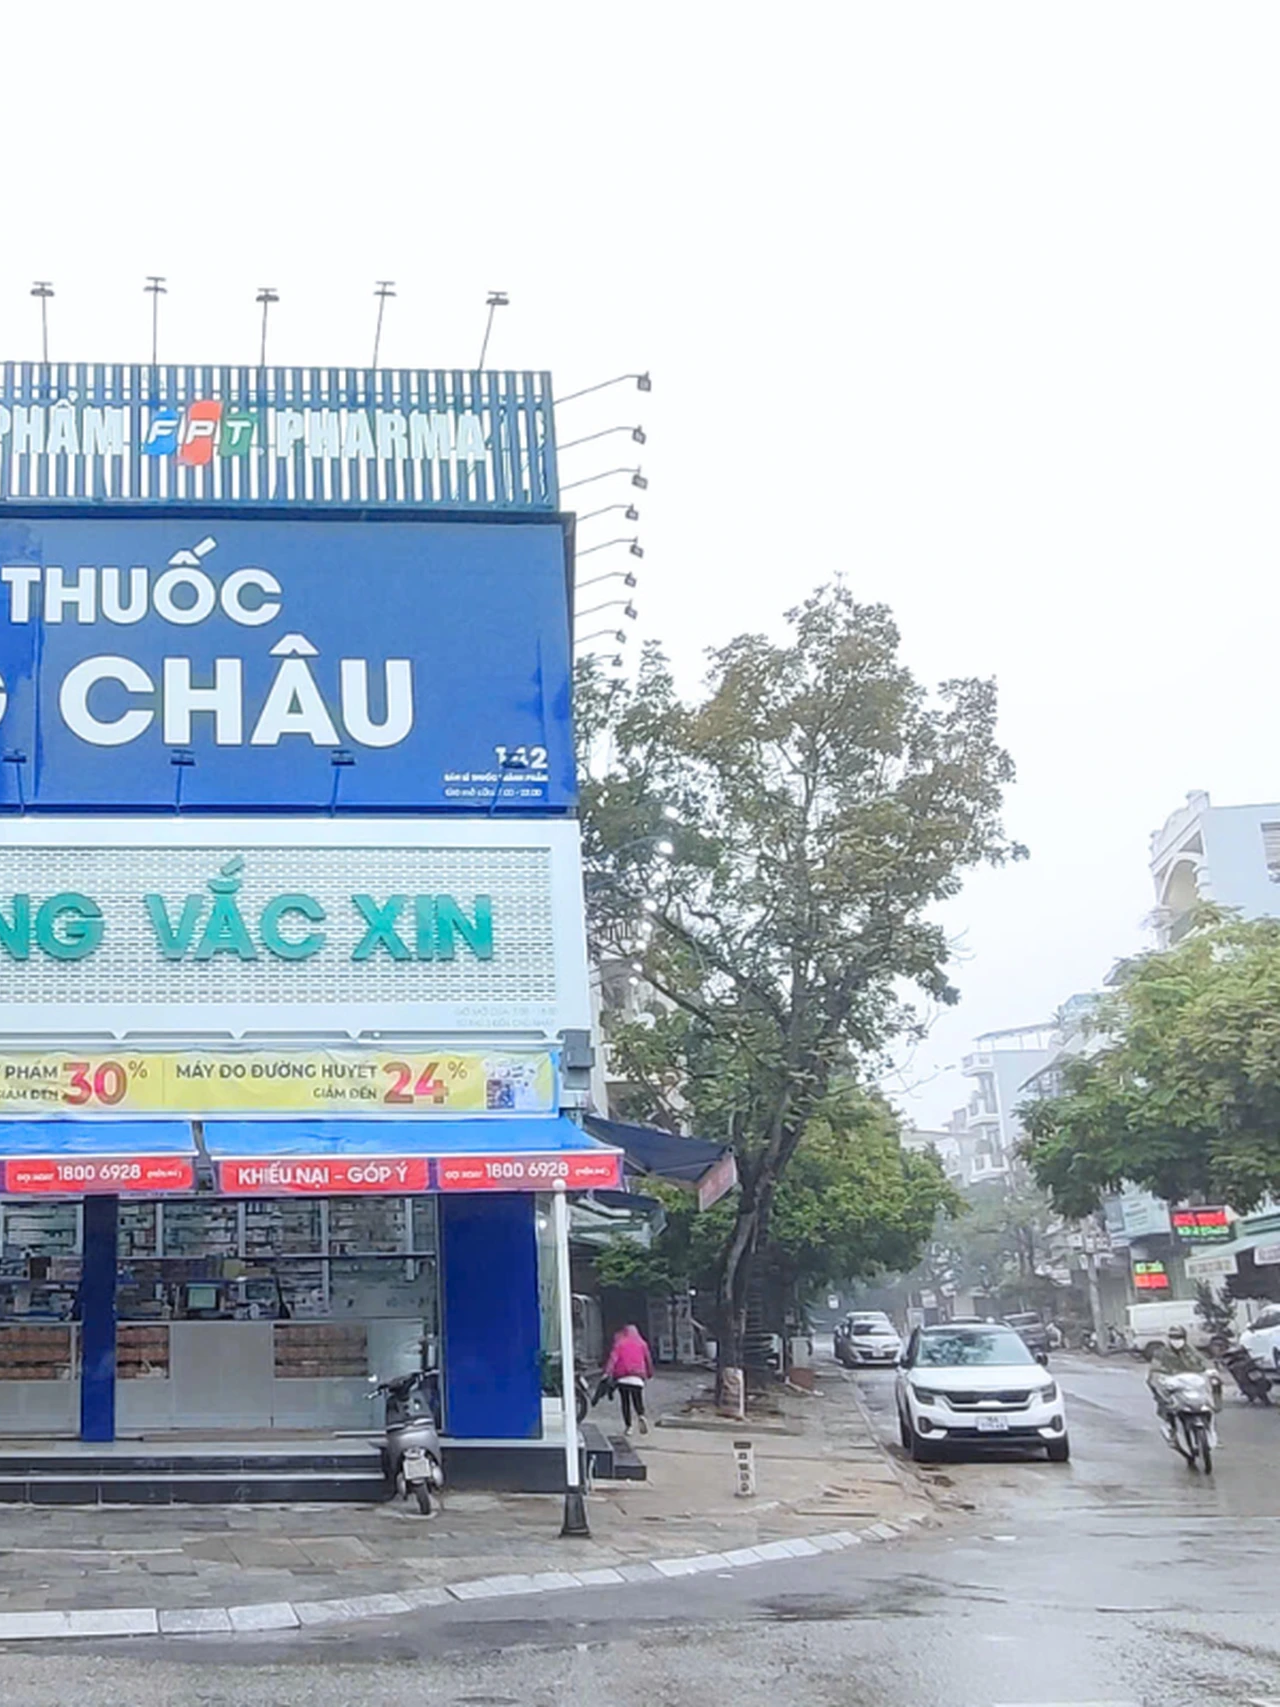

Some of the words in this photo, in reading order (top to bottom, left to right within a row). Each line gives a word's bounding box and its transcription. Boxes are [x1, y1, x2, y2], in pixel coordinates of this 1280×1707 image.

[145, 410, 255, 453] FPT
[276, 410, 487, 460] PHARMA
[1, 536, 282, 626] THUỐC
[59, 633, 414, 748] CHÂU
[143, 853, 327, 962] VẮC
[351, 892, 495, 961] XIN
[176, 1059, 215, 1078] MÁY
[219, 1064, 246, 1079] ĐO
[251, 1060, 317, 1079] ĐƯỜNG
[321, 1060, 378, 1079] HUYẾT
[58, 1165, 95, 1182] 1800
[99, 1164, 142, 1181] 6928
[295, 1167, 330, 1189] NẠI
[347, 1161, 391, 1183] GÓP
[396, 1161, 409, 1183] Ý
[485, 1163, 524, 1179] 1800
[527, 1161, 570, 1178] 6928
